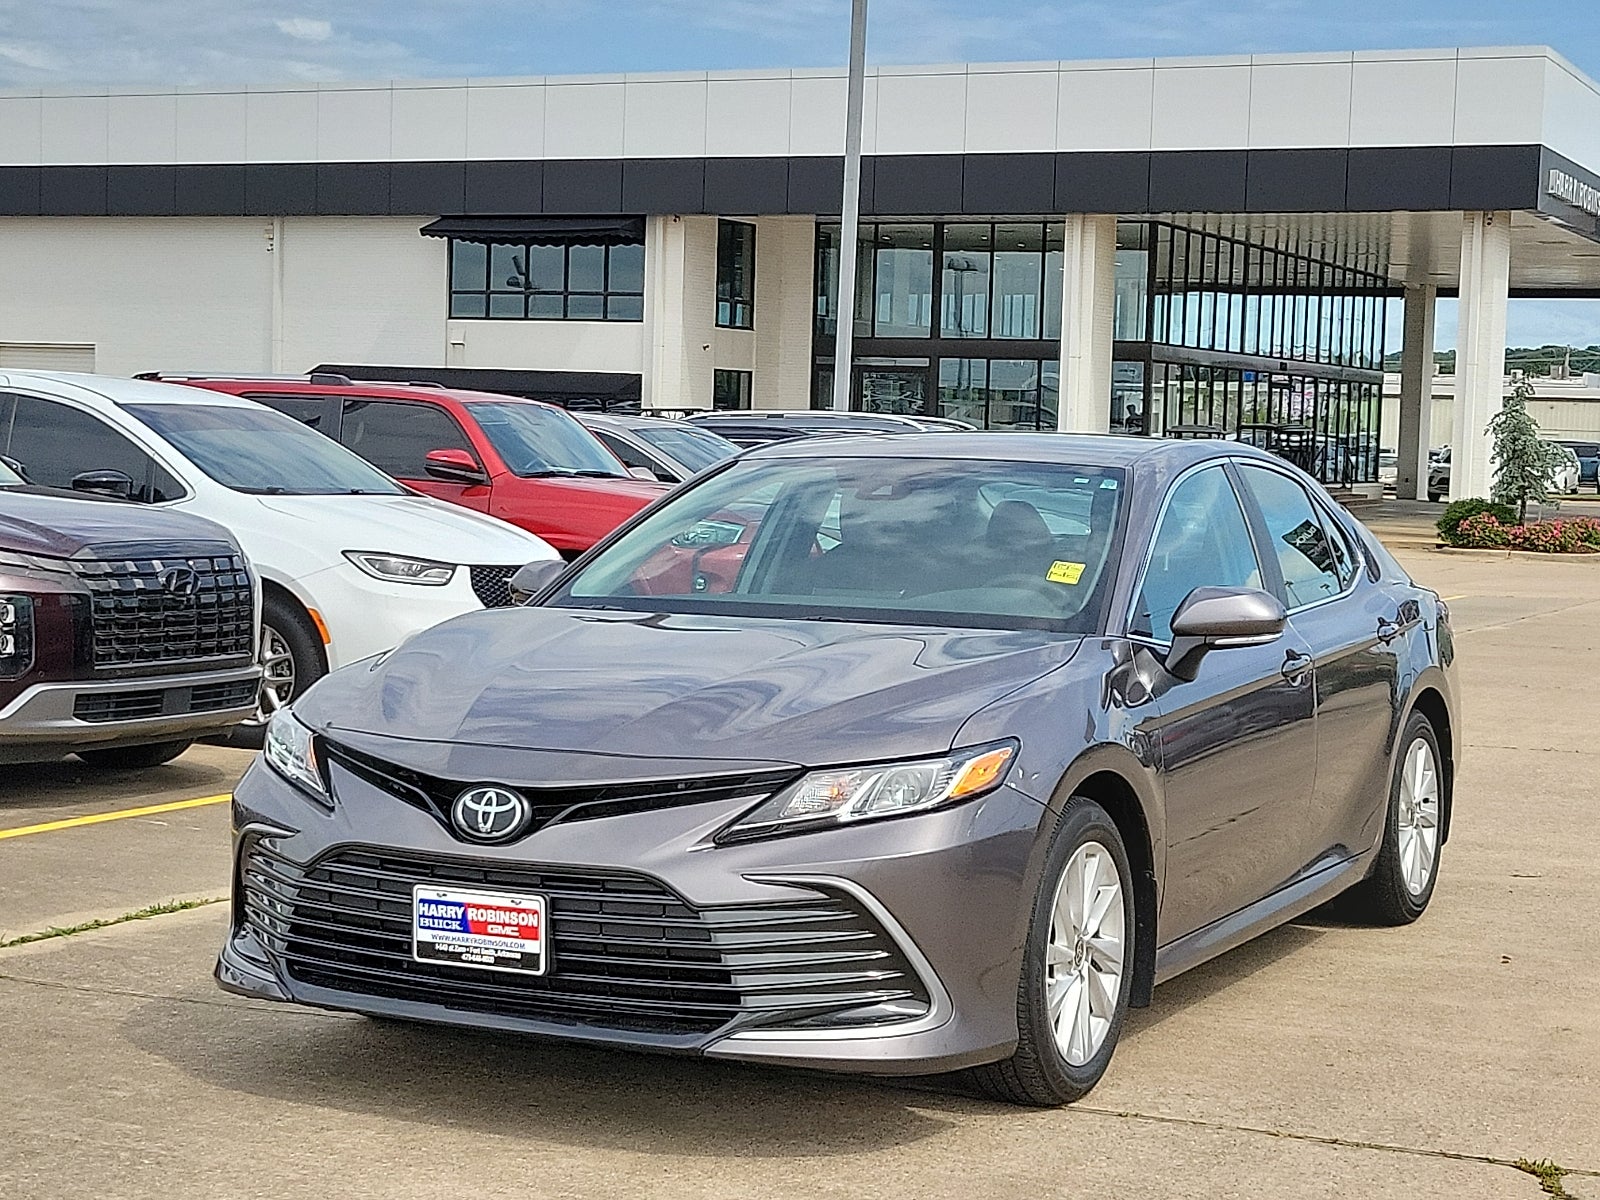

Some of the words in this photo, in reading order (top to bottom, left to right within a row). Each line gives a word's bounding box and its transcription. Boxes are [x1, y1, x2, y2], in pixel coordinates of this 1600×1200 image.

[419, 902, 465, 919] HARRY
[467, 907, 539, 927] ROBINSON
[420, 917, 461, 930] BUICK
[487, 924, 519, 936] GMC
